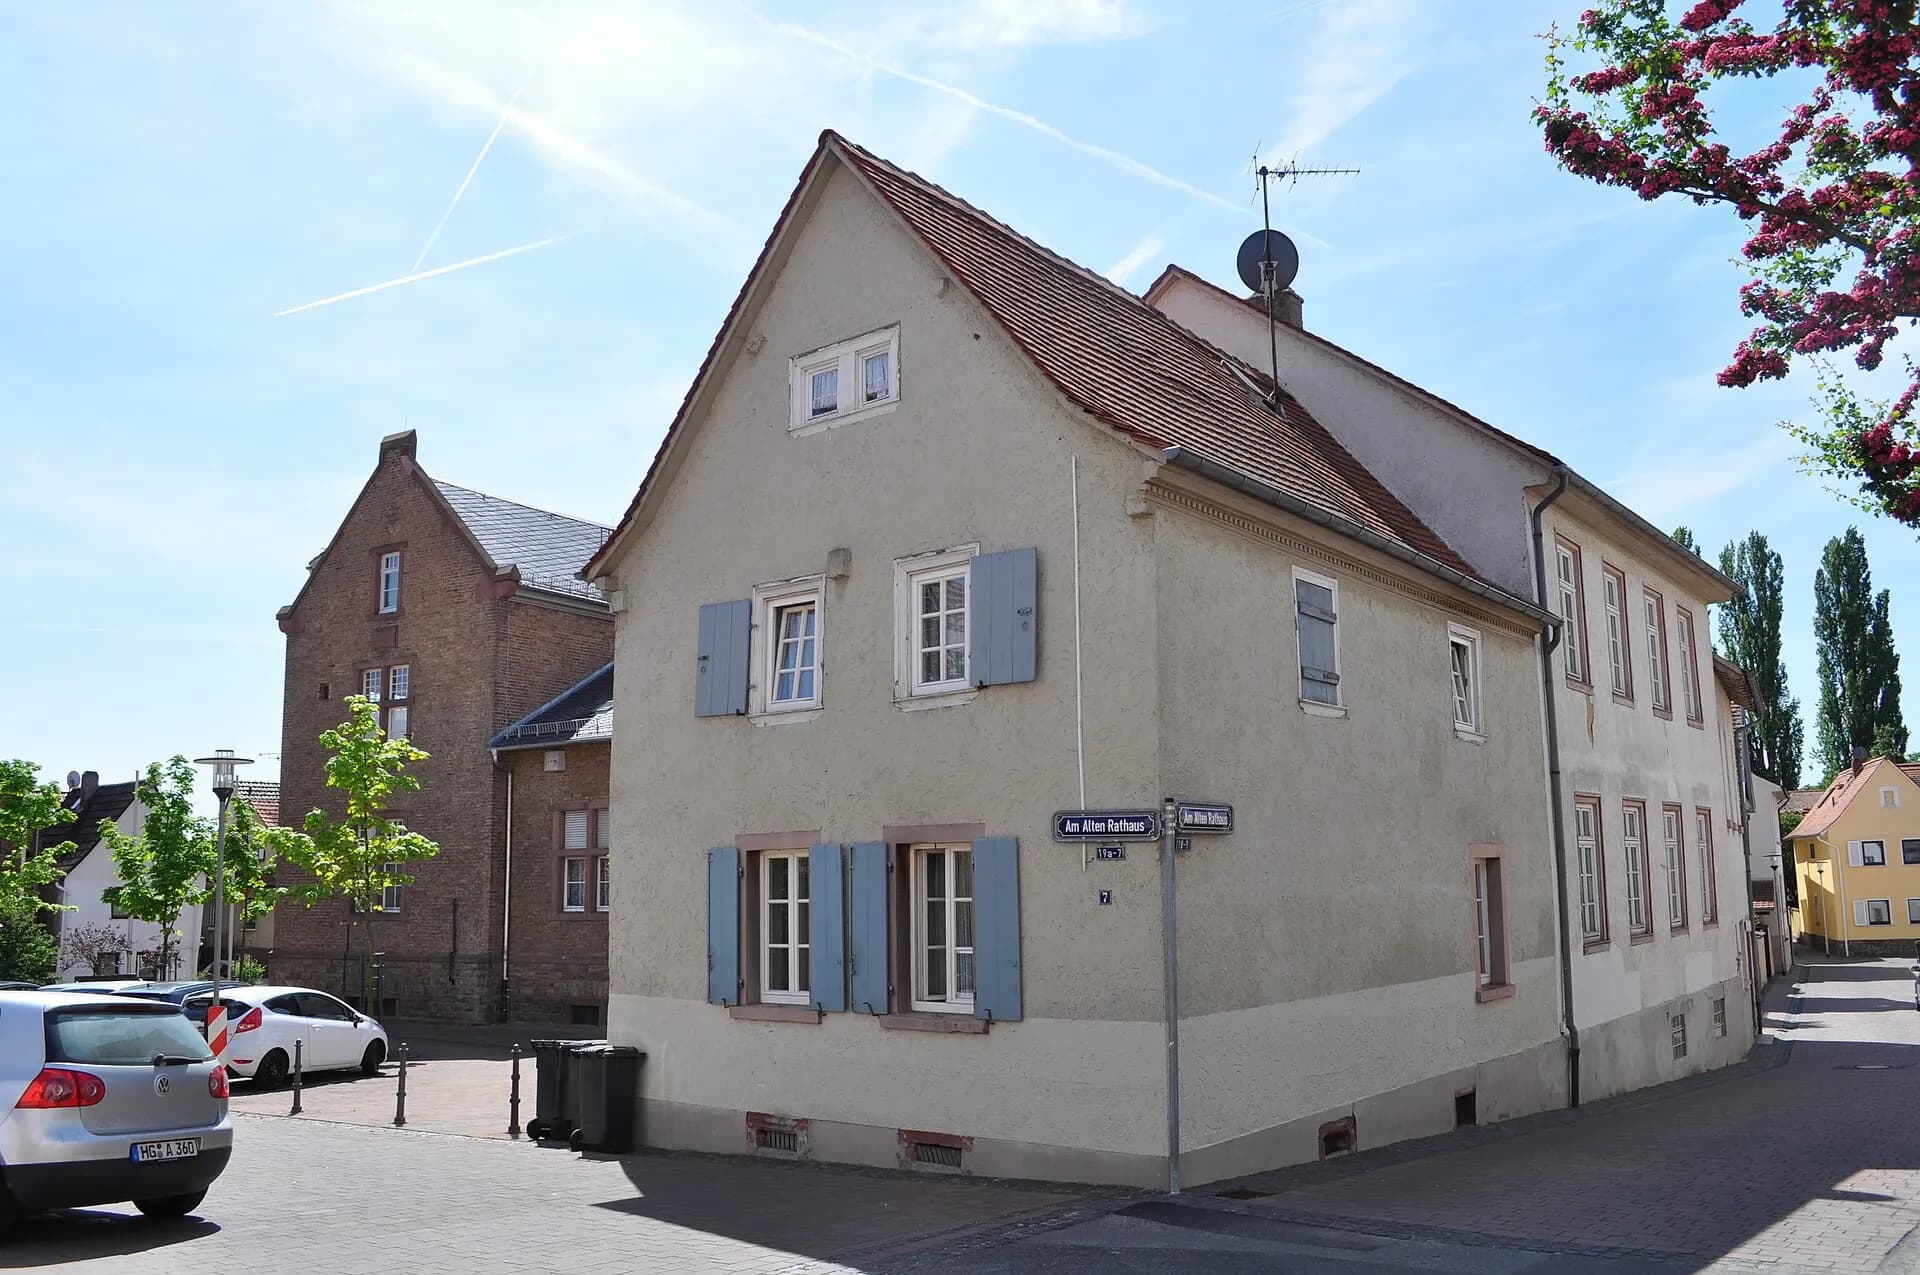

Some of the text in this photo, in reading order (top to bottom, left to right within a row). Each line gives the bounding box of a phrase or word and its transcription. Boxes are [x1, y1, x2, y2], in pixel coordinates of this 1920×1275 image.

[1065, 817, 1145, 833] Am Alten Rathaus
[1182, 810, 1228, 826] Am Alten Rathaus
[1098, 849, 1122, 859] 19a-7
[1102, 892, 1108, 903] 7
[157, 1076, 170, 1093] VW
[140, 1141, 195, 1160] HG A 360
